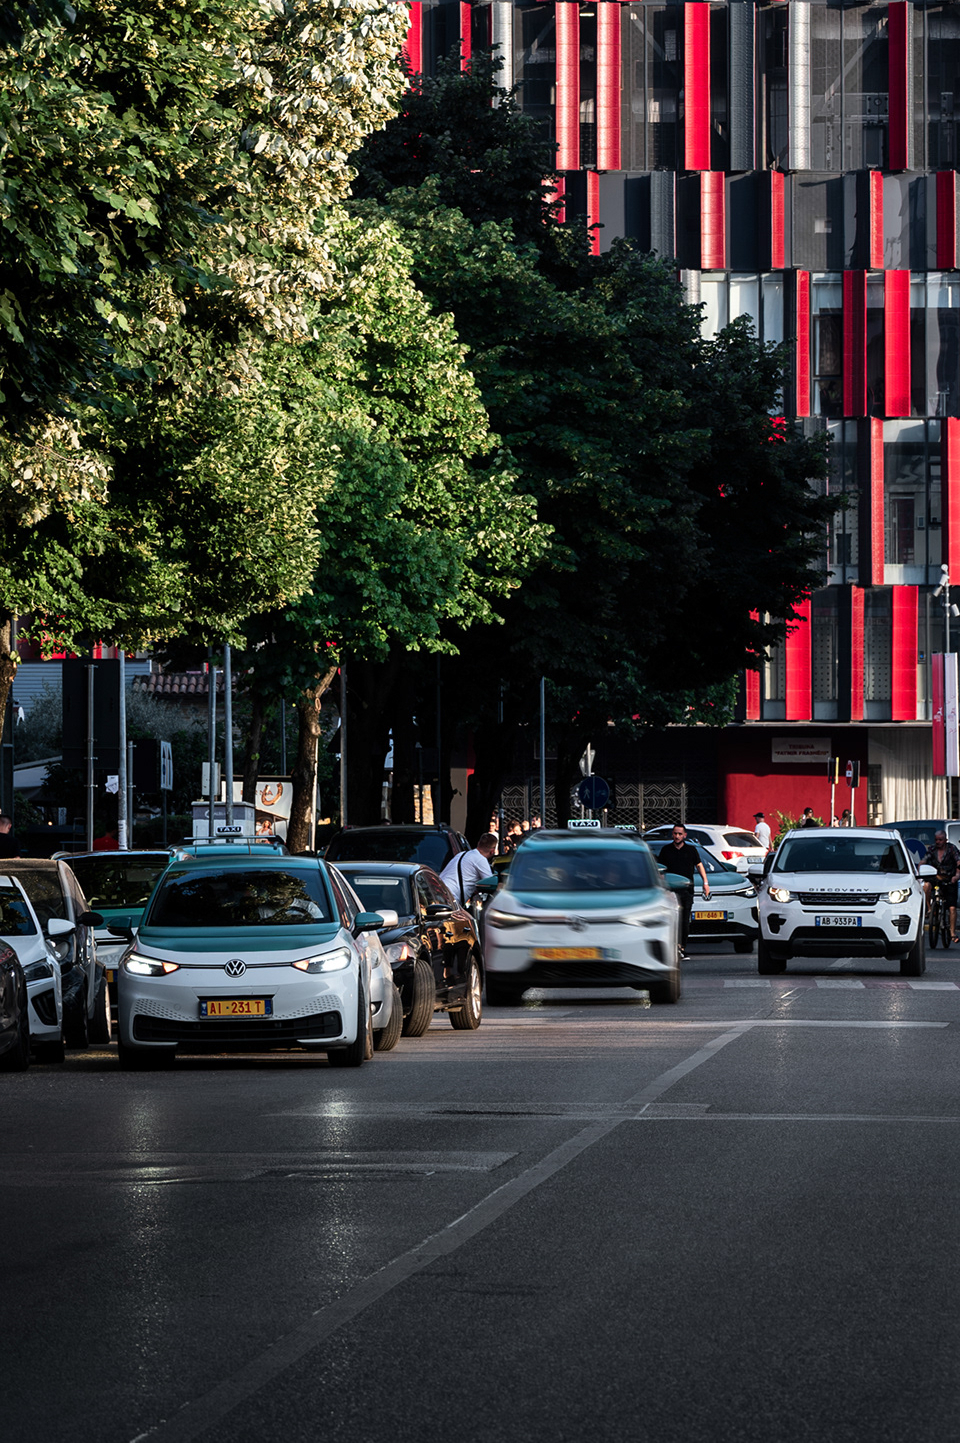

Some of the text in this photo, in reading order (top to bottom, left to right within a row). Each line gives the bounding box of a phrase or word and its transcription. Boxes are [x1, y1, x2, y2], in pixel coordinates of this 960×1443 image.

[821, 917, 831, 925] AB
[210, 1001, 262, 1014] AI 231 T
